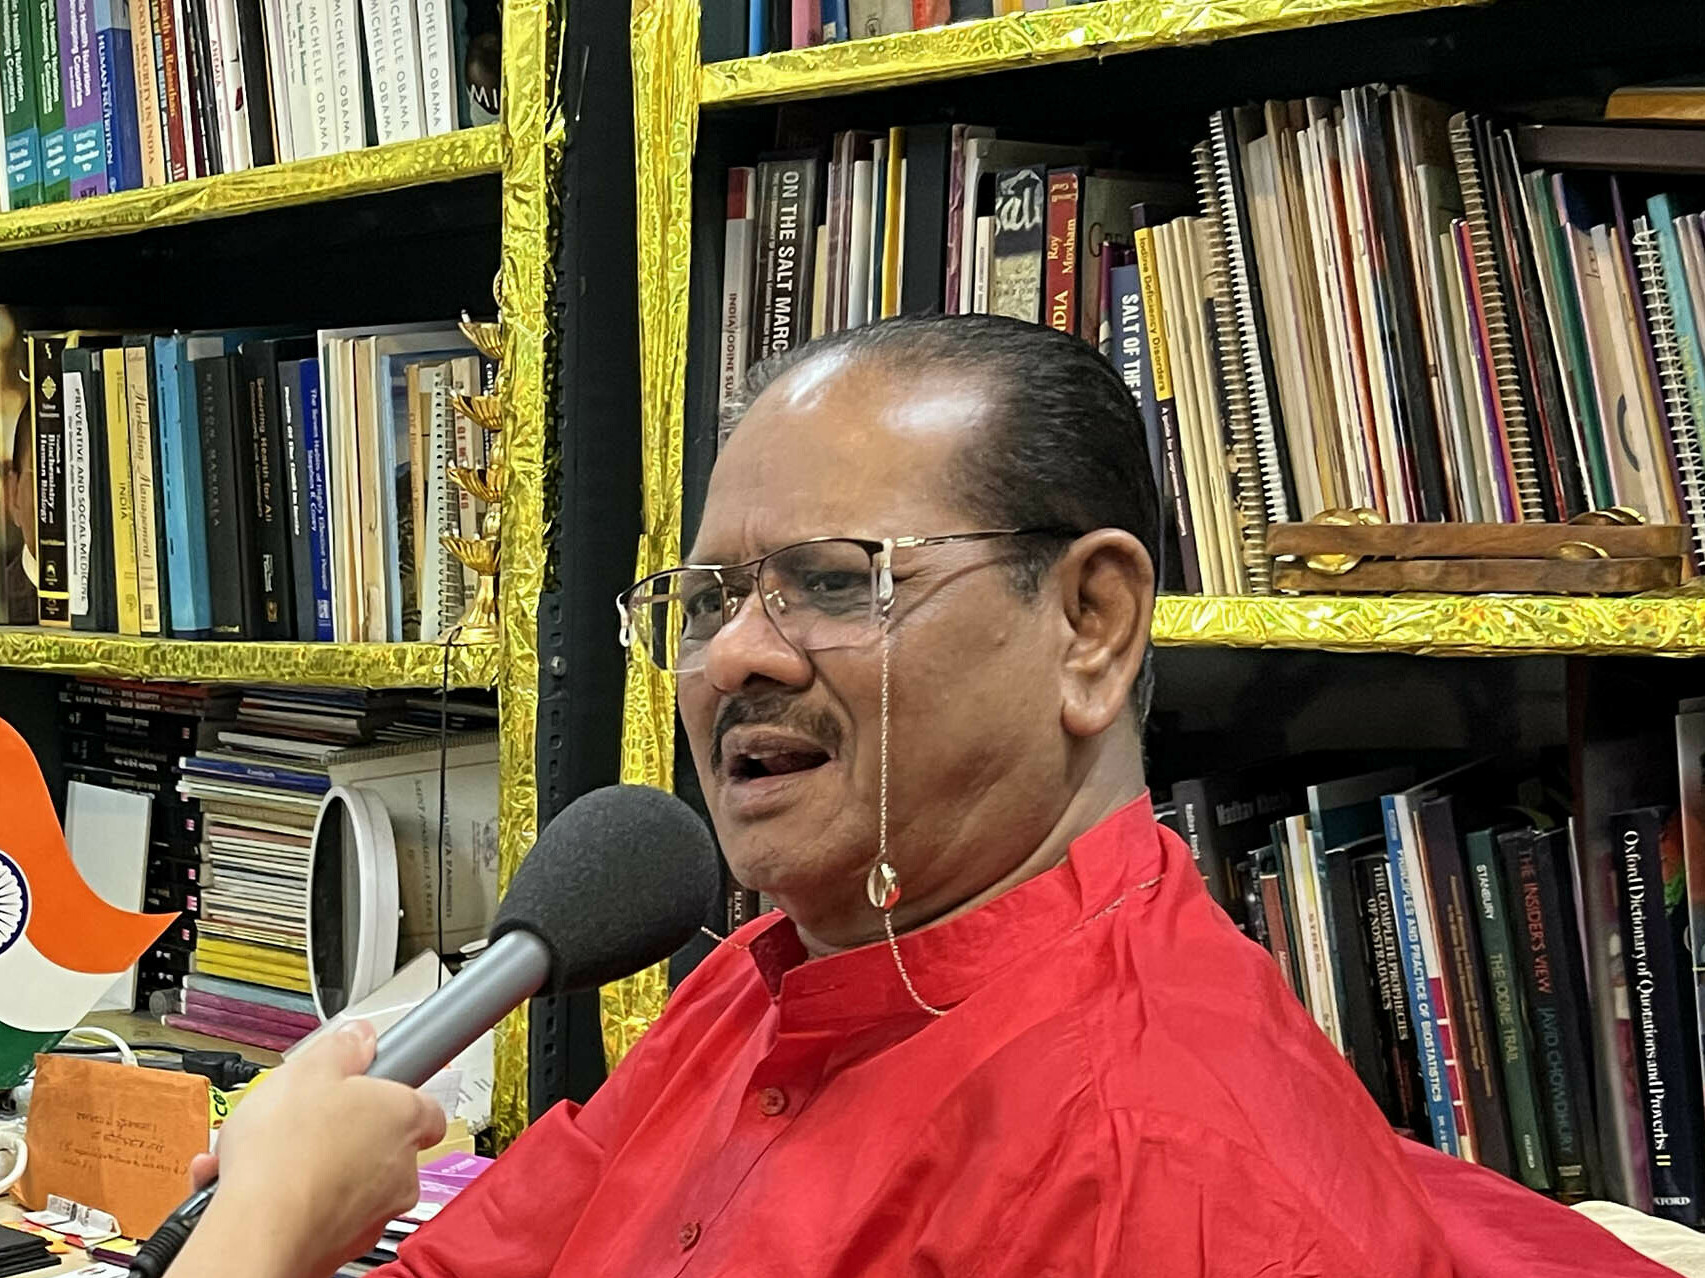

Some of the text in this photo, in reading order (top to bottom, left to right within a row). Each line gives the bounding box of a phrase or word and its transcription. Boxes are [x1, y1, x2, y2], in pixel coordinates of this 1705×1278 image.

[6, 58, 16, 113] Countries
[11, 14, 25, 101] Health Nutrition
[50, 56, 59, 102] Nutrition
[73, 56, 83, 107] Countries
[79, 13, 92, 97] Health Nutrition
[98, 35, 110, 88] HUMAN
[165, 54, 177, 117] Rajasthan
[211, 40, 221, 88] ANEMIA
[310, 5, 329, 151] MICHELLE OBAMA
[334, 0, 351, 145] MICHELLE OBAMA
[389, 0, 410, 131] ICHELLE OBAMA
[140, 36, 155, 165] SECURITY IN INDIA
[379, 81, 393, 142] OBAMA
[430, 66, 441, 128] OBAMA
[782, 171, 799, 198] ON
[778, 204, 798, 241] THE
[1048, 236, 1063, 260] Roy
[1062, 218, 1077, 274] Moxham
[775, 246, 794, 292] SALT
[725, 293, 737, 373] INDIA IODINE
[1122, 293, 1140, 335] SALT
[1140, 237, 1165, 392] Iodine Deficiency Disorders
[1123, 336, 1141, 358] OF
[74, 387, 83, 463] PREVENTIVE
[130, 383, 147, 460] Marketing
[257, 377, 266, 434] Securing
[311, 408, 319, 436] Seven
[39, 433, 50, 524] Human Biology
[47, 433, 57, 511] Biochemistry
[77, 465, 85, 493] AND
[260, 435, 269, 480] Health
[307, 449, 315, 490] Stephen
[314, 439, 322, 471] Habits
[119, 481, 127, 520] INDIA
[136, 463, 152, 557] Management
[209, 449, 221, 527] MANDELA
[265, 503, 273, 523] All
[317, 485, 325, 514] Highly
[318, 515, 326, 554] Effective
[79, 541, 88, 602] MEDICINE
[1518, 849, 1532, 878] THE
[1522, 882, 1546, 953] INSIDER'S
[1367, 898, 1392, 1010] OF NOSTRADAMUS
[1374, 864, 1408, 1040] THE COMPLETE PROPHECIES
[1397, 849, 1441, 1102] PRINCIPLES AND PRACTICE OF BIOSTATISTICS
[1476, 864, 1518, 1064] STANBURY THE IODINE TRAIL
[1535, 955, 1553, 994] VIEW
[1623, 830, 1669, 1150] Oxford Dictionary of Quotations and Proverbs
[1548, 1051, 1574, 1154] CHOWDHURY
